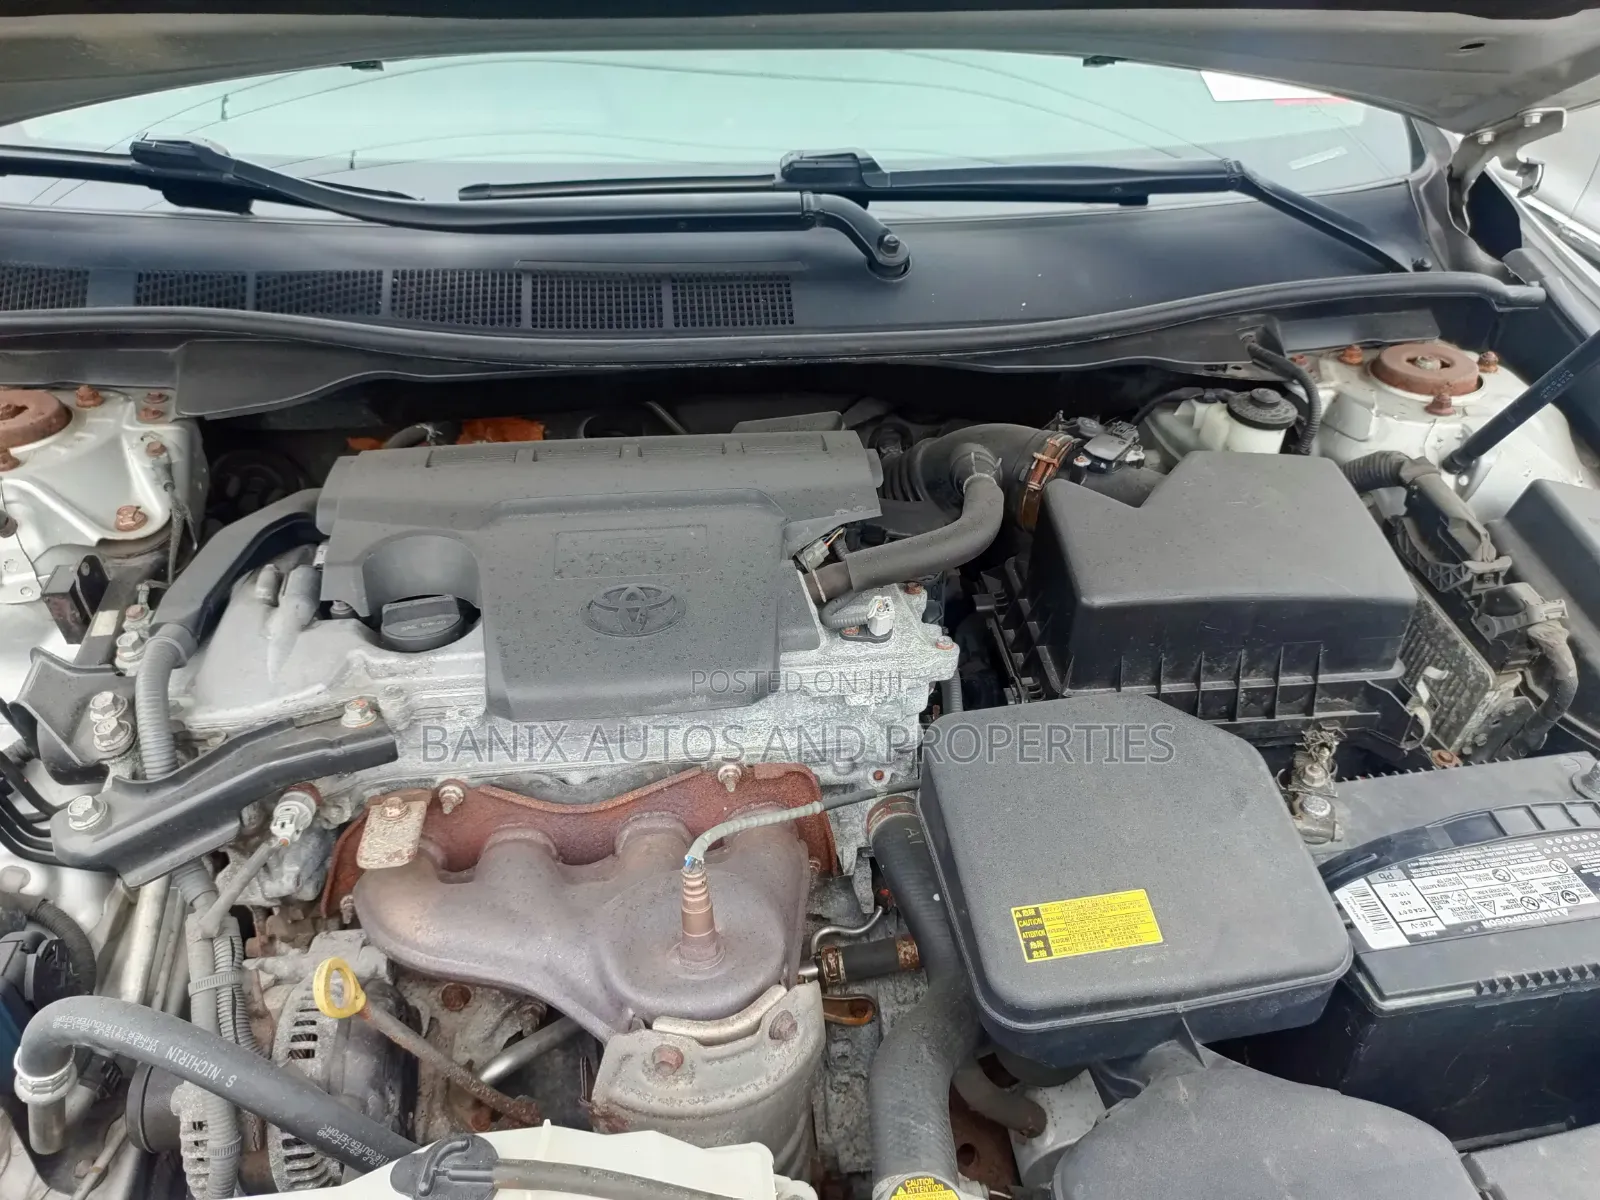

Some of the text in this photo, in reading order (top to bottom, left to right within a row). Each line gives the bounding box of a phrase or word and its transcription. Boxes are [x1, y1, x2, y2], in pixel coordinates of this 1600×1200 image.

[1377, 871, 1394, 881] Pb
[1018, 918, 1043, 927] CAUTION
[905, 1177, 935, 1187] CAUTION
[907, 1184, 945, 1194] ATTENTION
